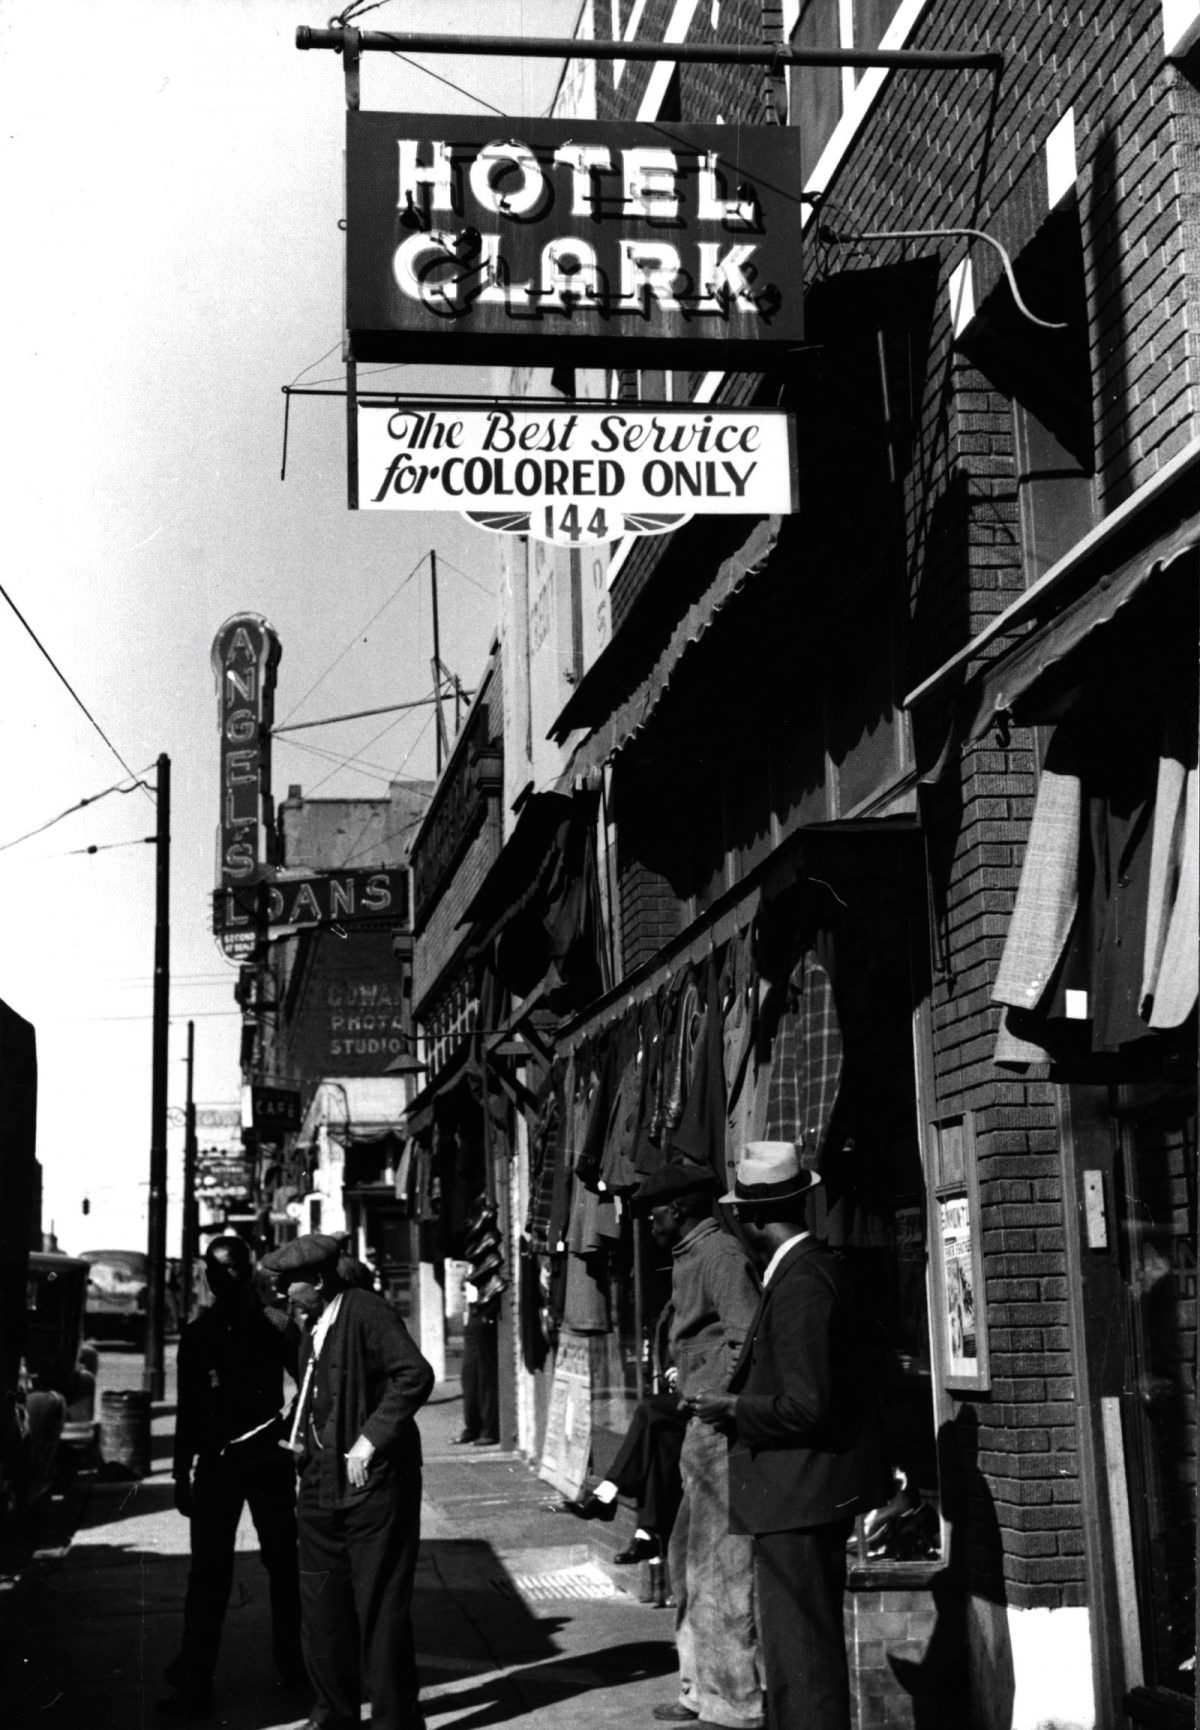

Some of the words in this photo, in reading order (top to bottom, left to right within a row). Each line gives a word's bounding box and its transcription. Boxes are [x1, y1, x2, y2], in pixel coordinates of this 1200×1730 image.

[396, 138, 760, 221] HOTEL
[392, 229, 764, 314] CLARK
[387, 410, 464, 449] The
[482, 410, 578, 452] Best
[590, 415, 761, 453] Service
[371, 453, 440, 502] for
[441, 456, 626, 497] COLORED
[642, 459, 758, 497] ONLY
[545, 503, 609, 541] 144
[224, 874, 392, 927] LOANS
[329, 1037, 401, 1055] STUDIO
